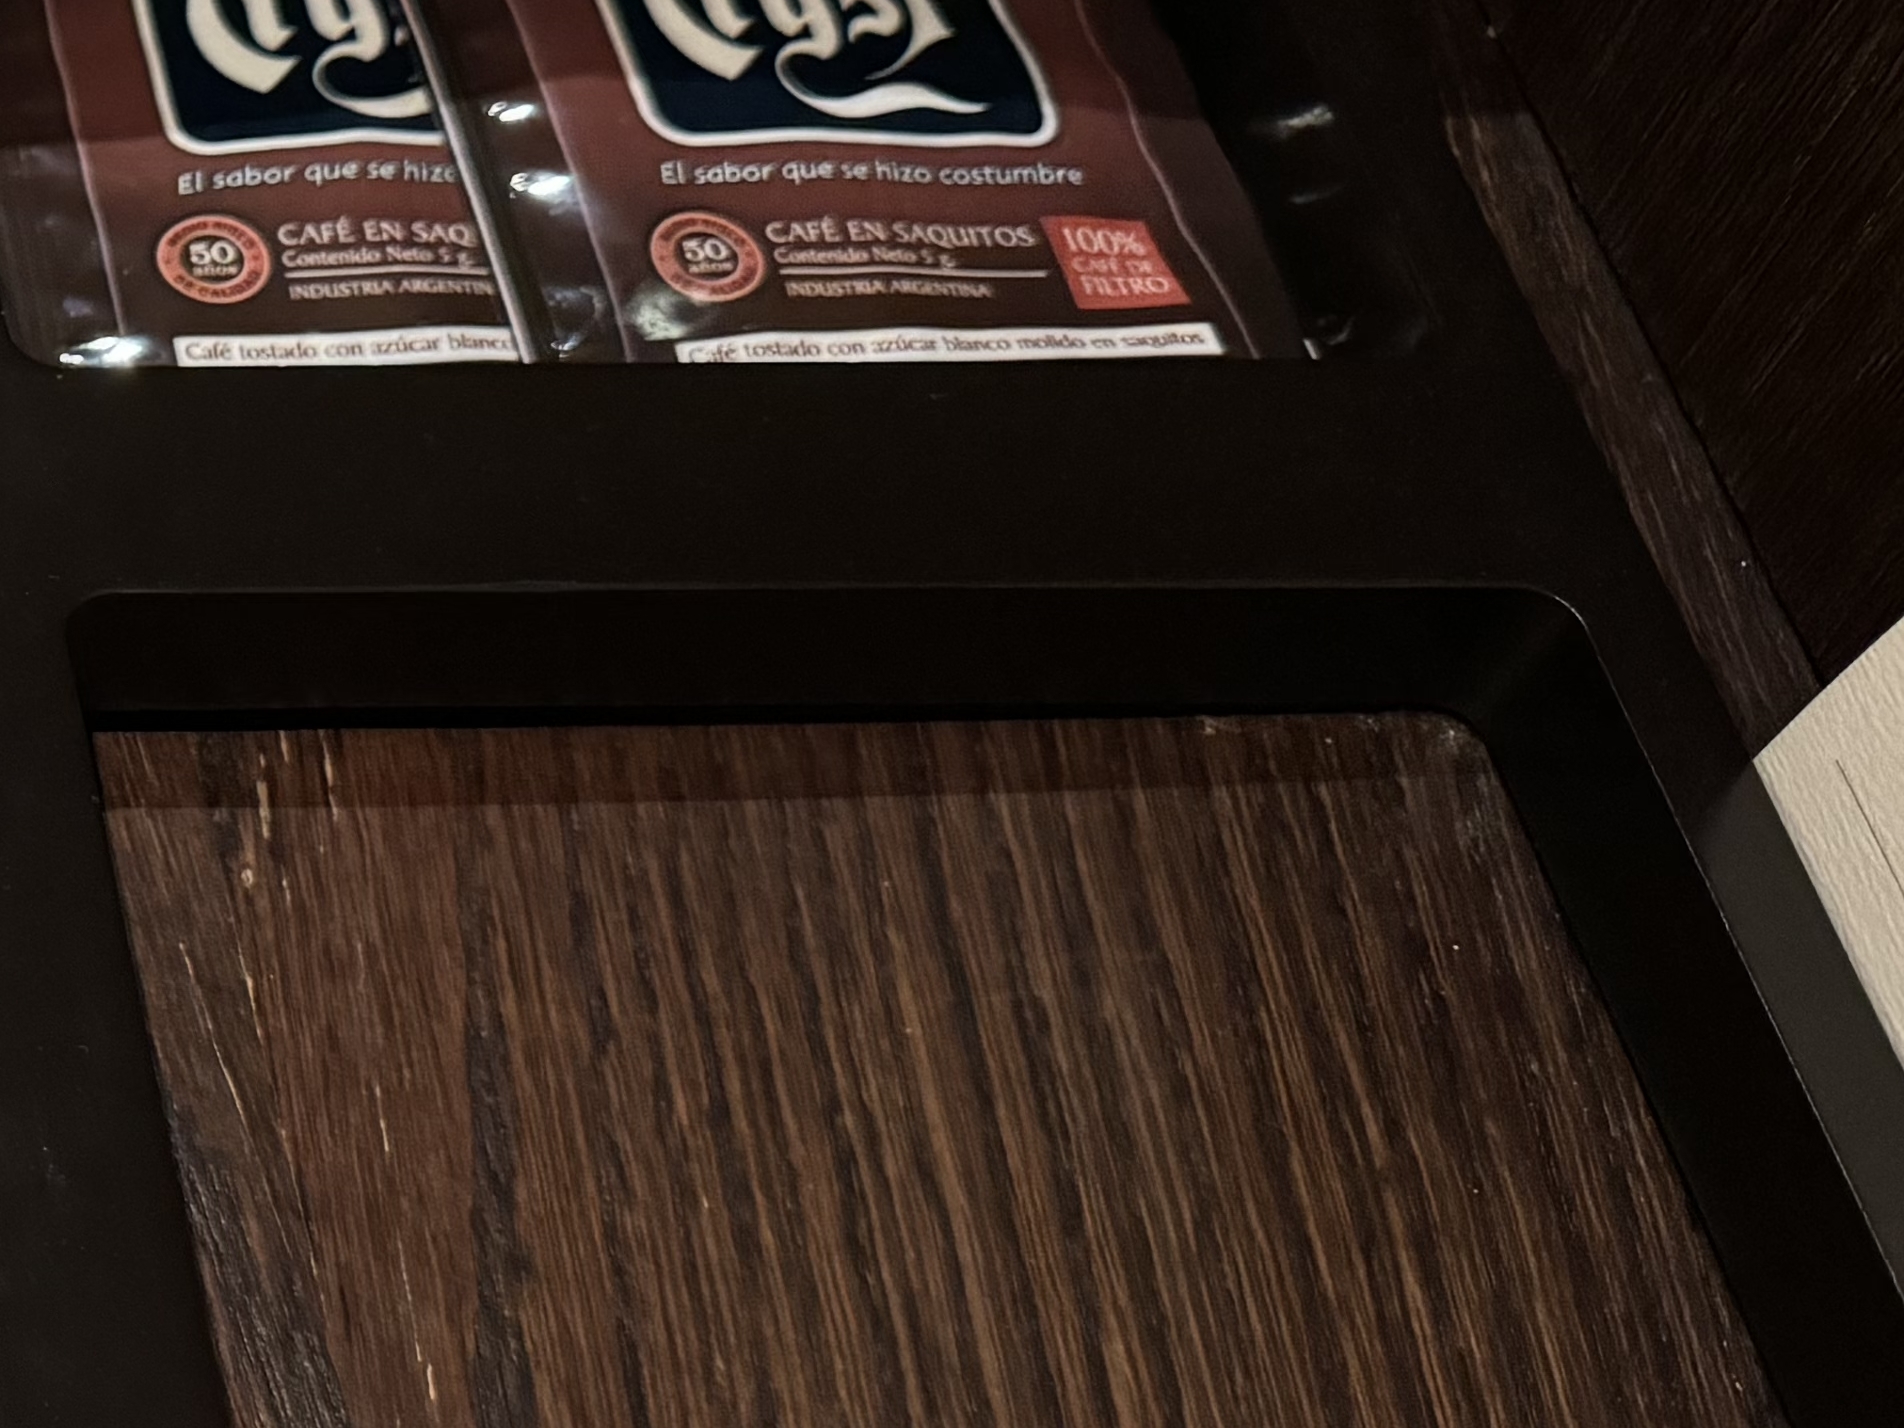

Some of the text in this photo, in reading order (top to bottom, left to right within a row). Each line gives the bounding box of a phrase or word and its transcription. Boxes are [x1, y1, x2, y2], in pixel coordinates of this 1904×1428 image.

[178, 171, 202, 195] El
[212, 164, 296, 190] sabor
[304, 160, 359, 186] que
[367, 161, 397, 178] se
[660, 160, 1084, 186] El sabor que se hizo costumbre
[278, 215, 360, 248] CAFÉ
[363, 221, 404, 244] EN
[765, 216, 841, 243] CAFÉ
[846, 221, 888, 243] EN
[895, 222, 1038, 249] SAQUITOS
[1062, 226, 1147, 257] 100%
[189, 240, 238, 265] 50
[281, 246, 382, 268] Contenido
[386, 246, 434, 263] Neto
[682, 238, 729, 263] 50
[774, 246, 915, 264] Contenido Neto
[289, 280, 393, 301] INDUSTRIA
[784, 279, 993, 299] INDUSTRIA ARGENTINA
[1080, 275, 1170, 297] FILTRO
[184, 341, 233, 362] Café
[239, 340, 318, 362] tostado
[325, 342, 363, 358] con
[370, 333, 440, 355] azúcar
[744, 340, 820, 359] tostado
[826, 343, 865, 358] con
[871, 335, 938, 353] azúcar
[943, 333, 1011, 352] blanco
[1017, 331, 1086, 350] molido
[1090, 335, 1116, 349] en
[1121, 330, 1205, 352] saquitos
